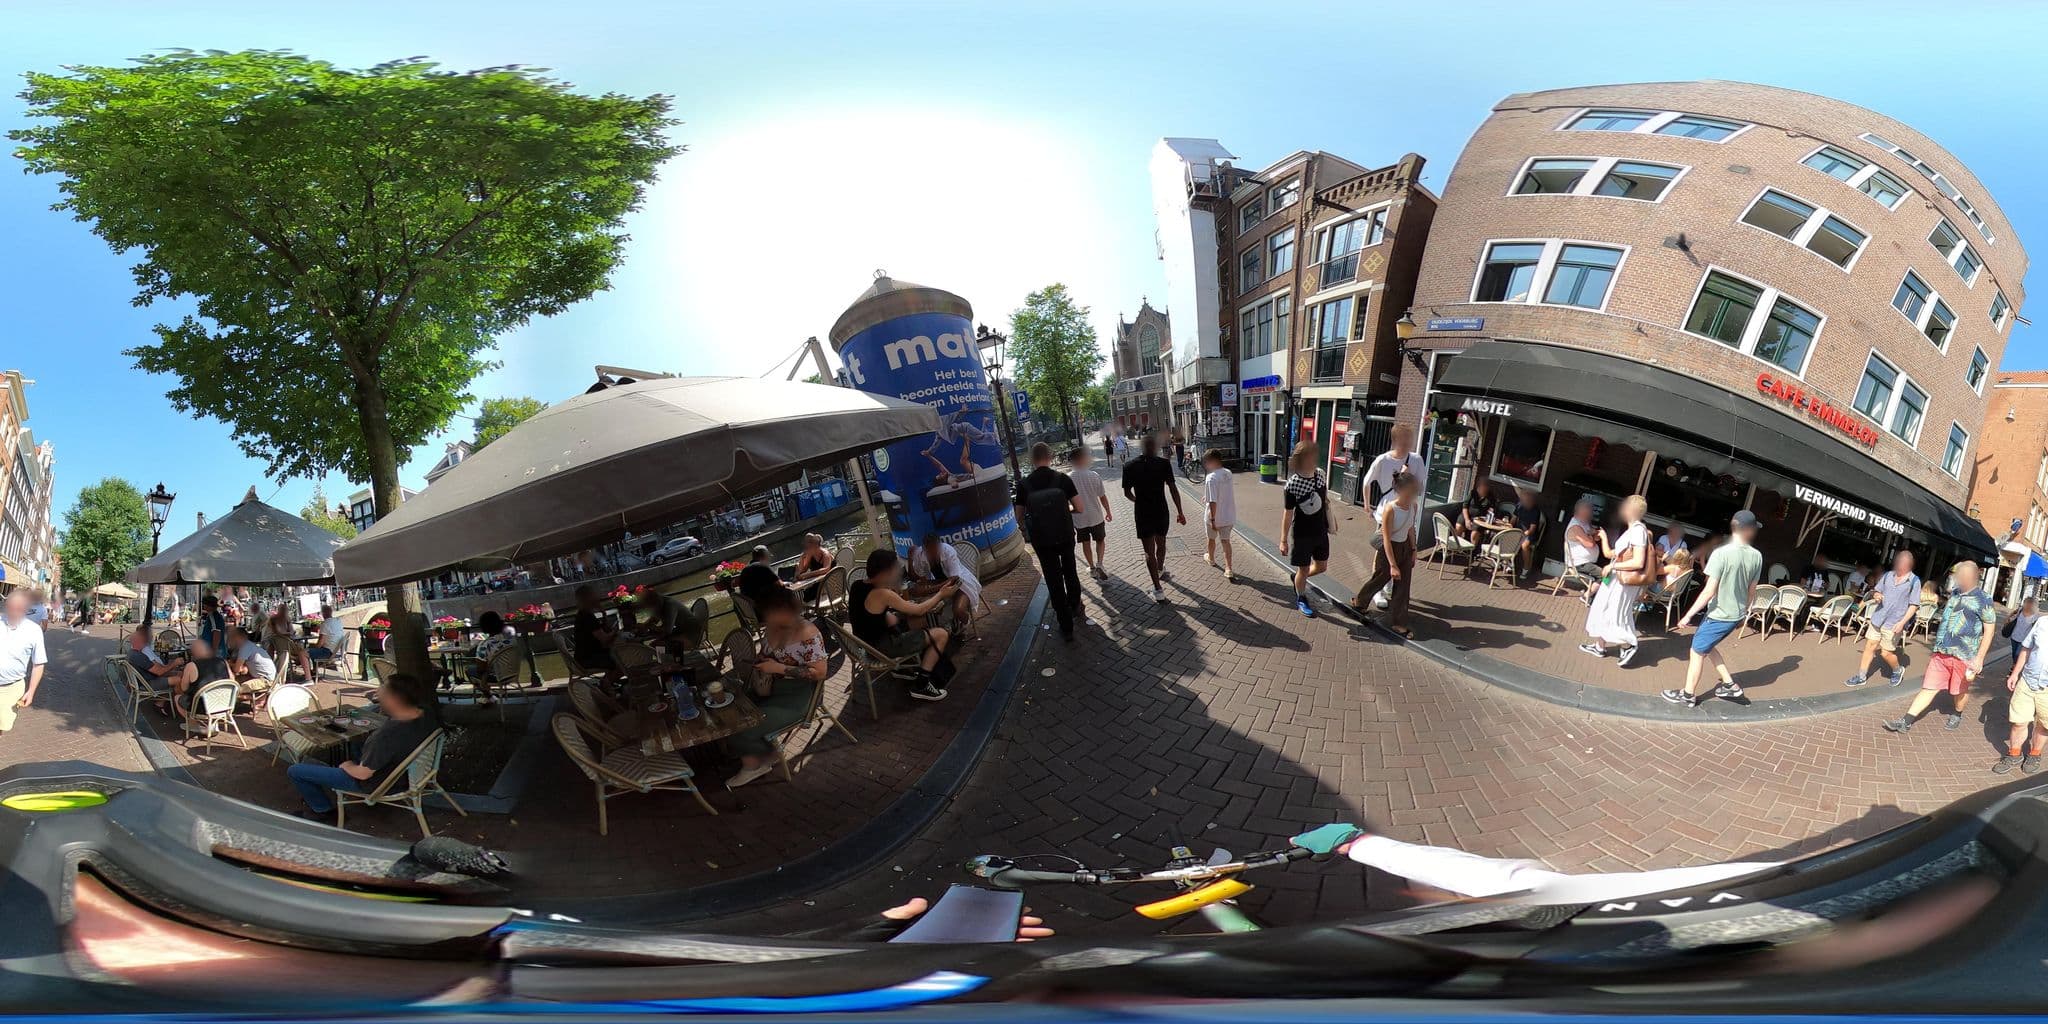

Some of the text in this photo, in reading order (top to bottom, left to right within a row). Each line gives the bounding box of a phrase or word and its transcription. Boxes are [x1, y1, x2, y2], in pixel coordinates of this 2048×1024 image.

[935, 369, 956, 381] Het
[900, 380, 974, 401] beoordeelde
[1017, 393, 1025, 409] P
[1461, 398, 1513, 416] AMSTEL
[1756, 372, 1879, 448] CAFE EMMELOT
[1795, 484, 1905, 535] VERWARMD TERRAS
